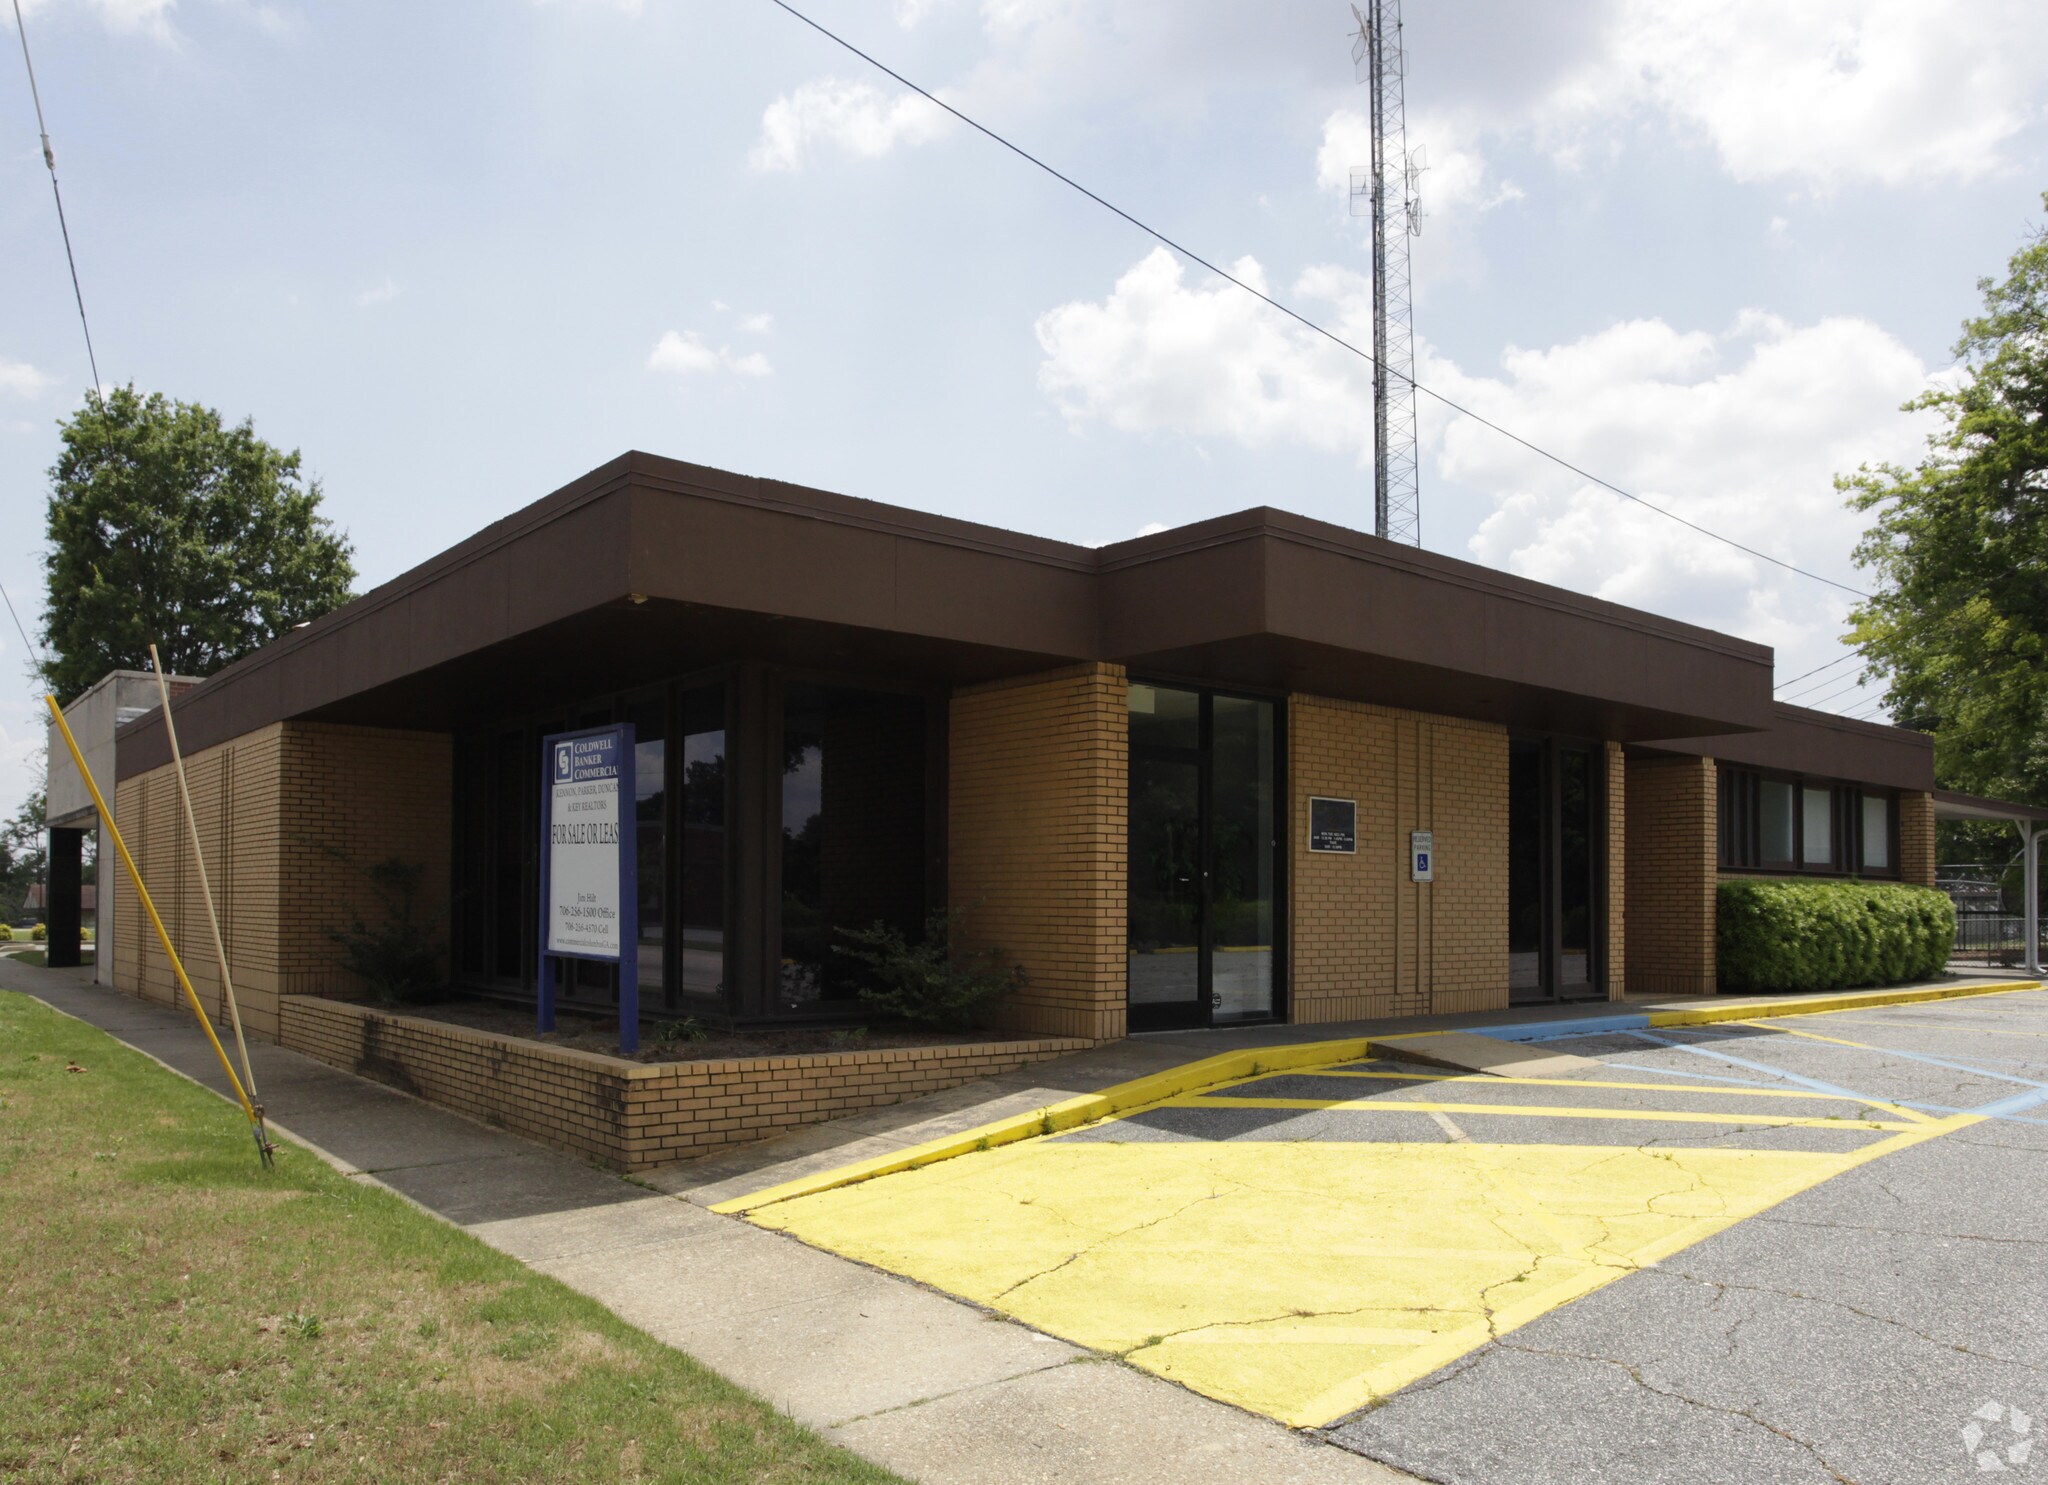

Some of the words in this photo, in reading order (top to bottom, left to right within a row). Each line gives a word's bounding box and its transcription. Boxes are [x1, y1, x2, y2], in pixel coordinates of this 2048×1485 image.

[574, 739, 613, 754] COLDWELL
[574, 754, 602, 767] BANKER
[574, 765, 618, 780] COMMERCIA
[582, 800, 607, 810] REALTORS
[552, 824, 567, 845] FOR
[568, 823, 585, 845] SALE
[587, 823, 599, 845] OR
[599, 822, 619, 845] LEAS
[559, 905, 597, 918] 706-256-1500
[597, 907, 616, 919] Office
[598, 924, 609, 934] Cell
